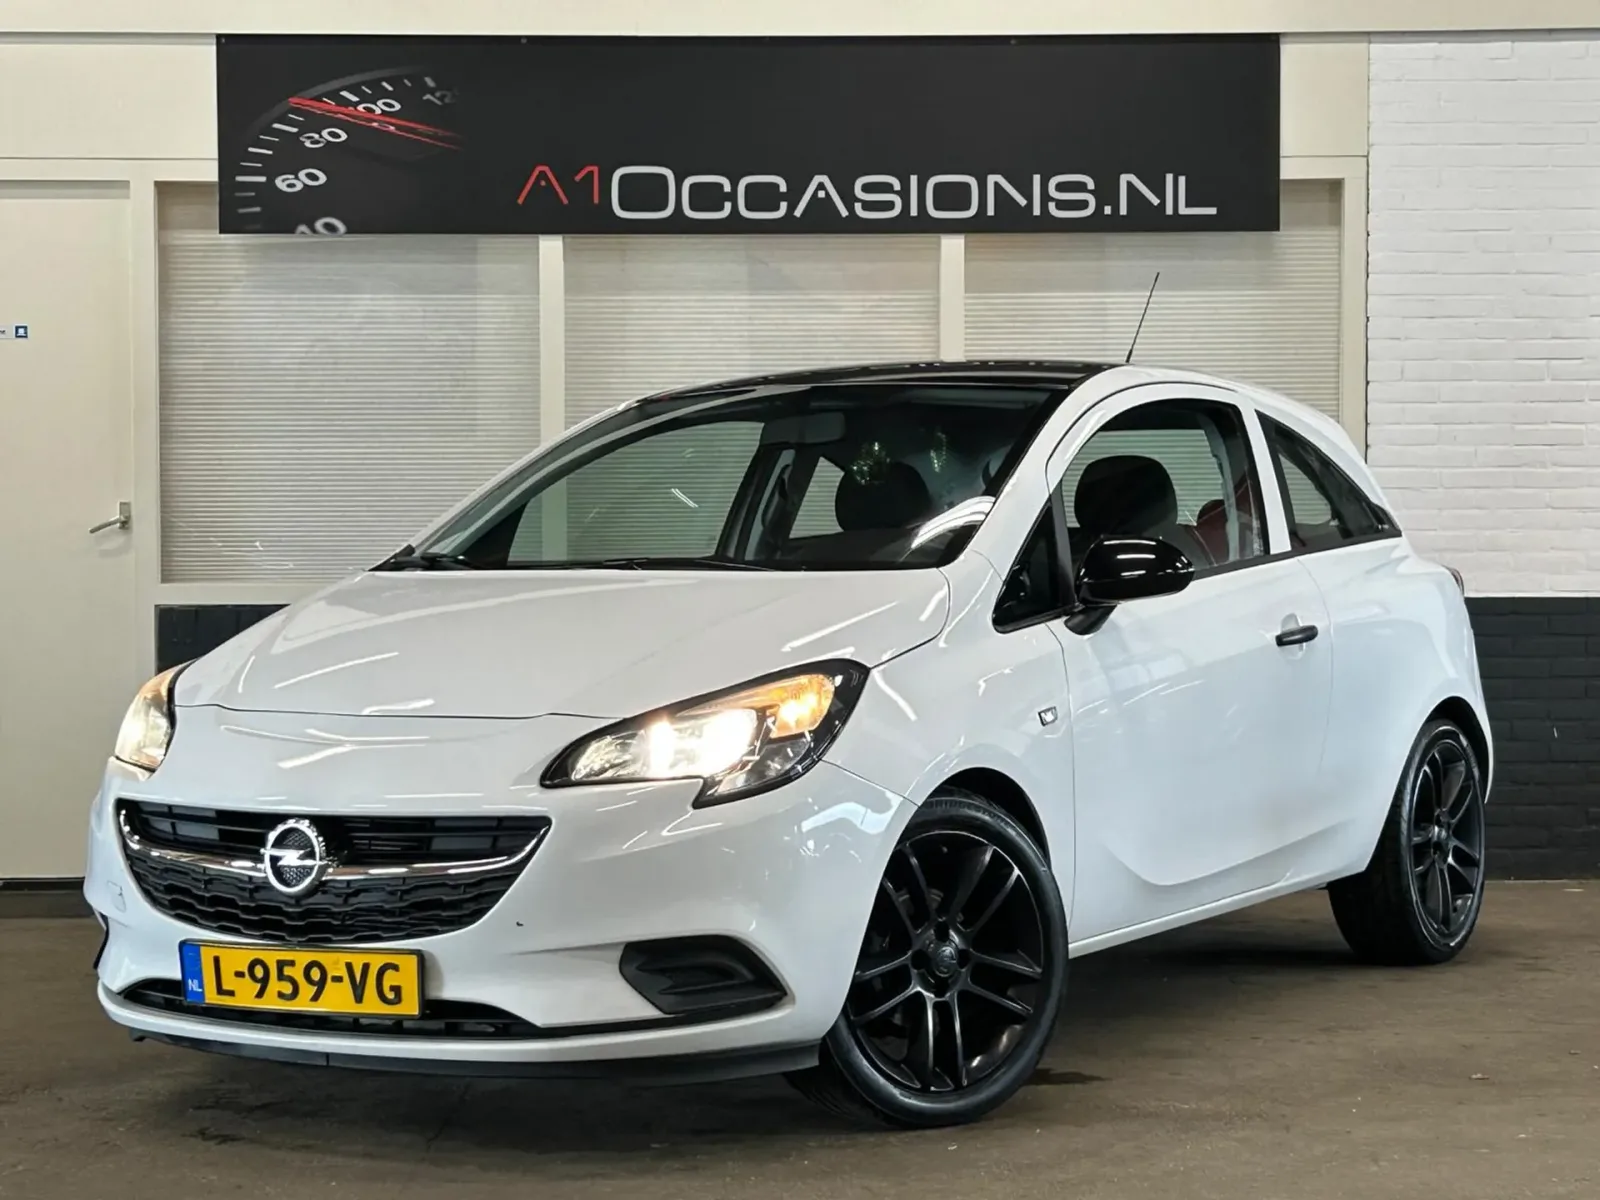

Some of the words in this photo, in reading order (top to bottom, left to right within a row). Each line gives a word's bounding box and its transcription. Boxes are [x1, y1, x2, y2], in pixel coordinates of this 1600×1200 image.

[299, 128, 348, 149] 80
[275, 168, 327, 193] 60
[188, 979, 203, 992] NL
[212, 955, 403, 1006] L-959-VG
